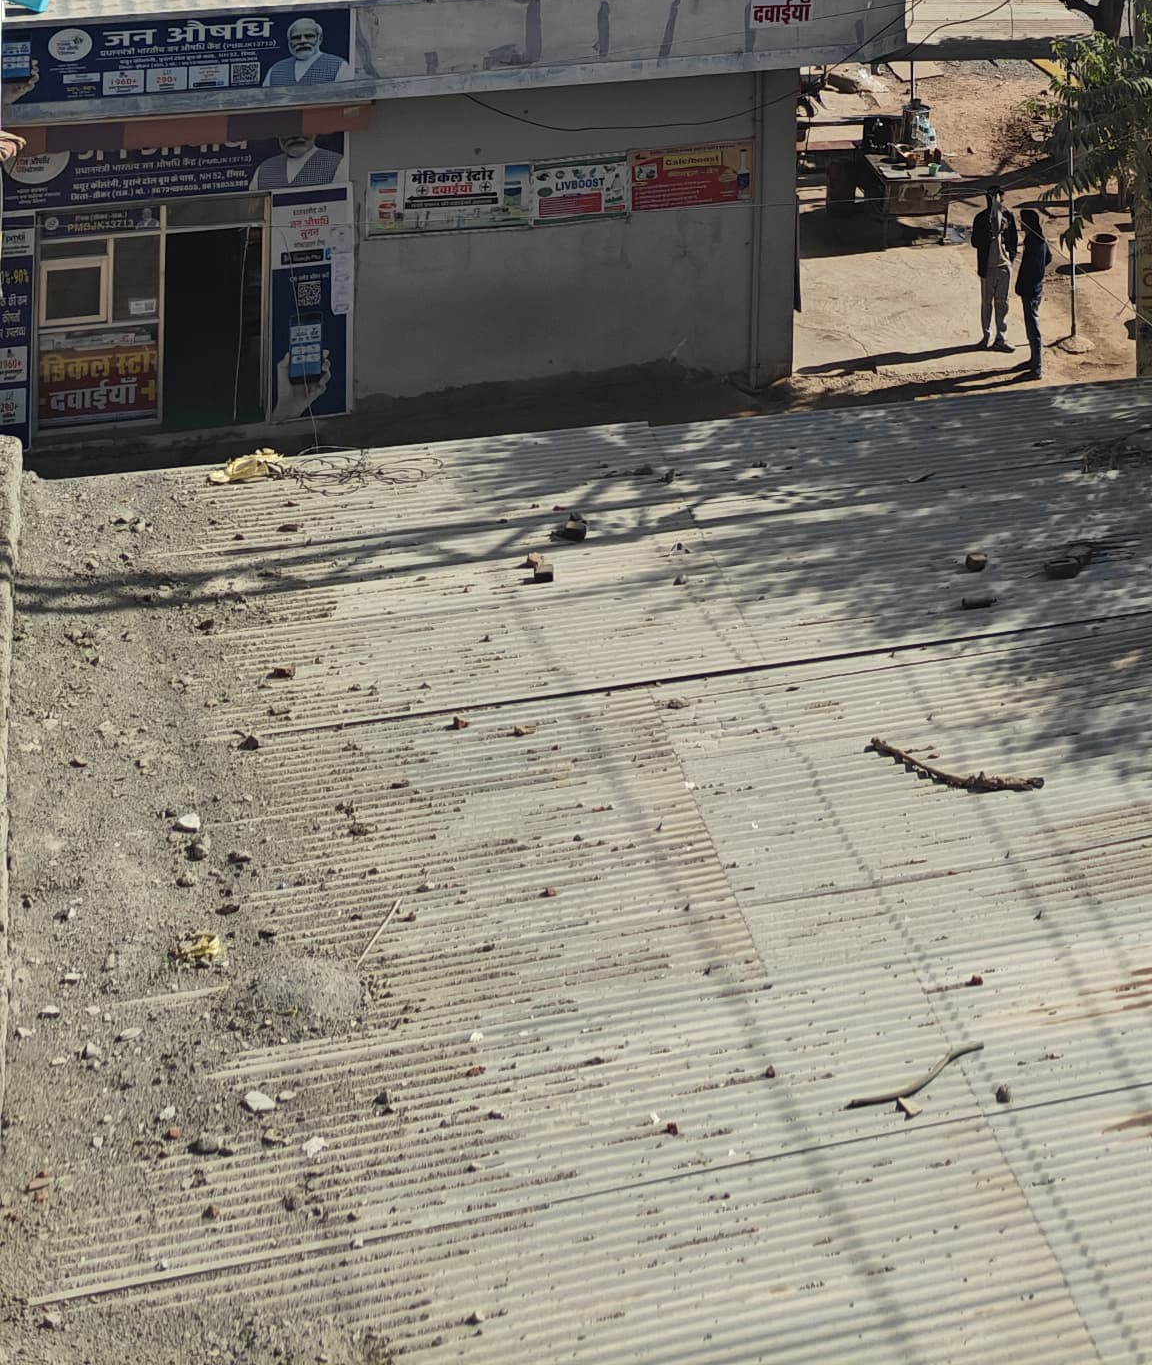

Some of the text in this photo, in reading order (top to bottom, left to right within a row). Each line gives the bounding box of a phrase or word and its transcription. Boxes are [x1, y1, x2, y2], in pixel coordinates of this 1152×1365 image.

[102, 17, 275, 47] जन औषधि
[411, 166, 495, 184] मेडिकल स्टोर
[555, 177, 606, 191] LIVBOOST
[40, 352, 110, 383] डिकल
[49, 377, 139, 411] दवाईयाँ
